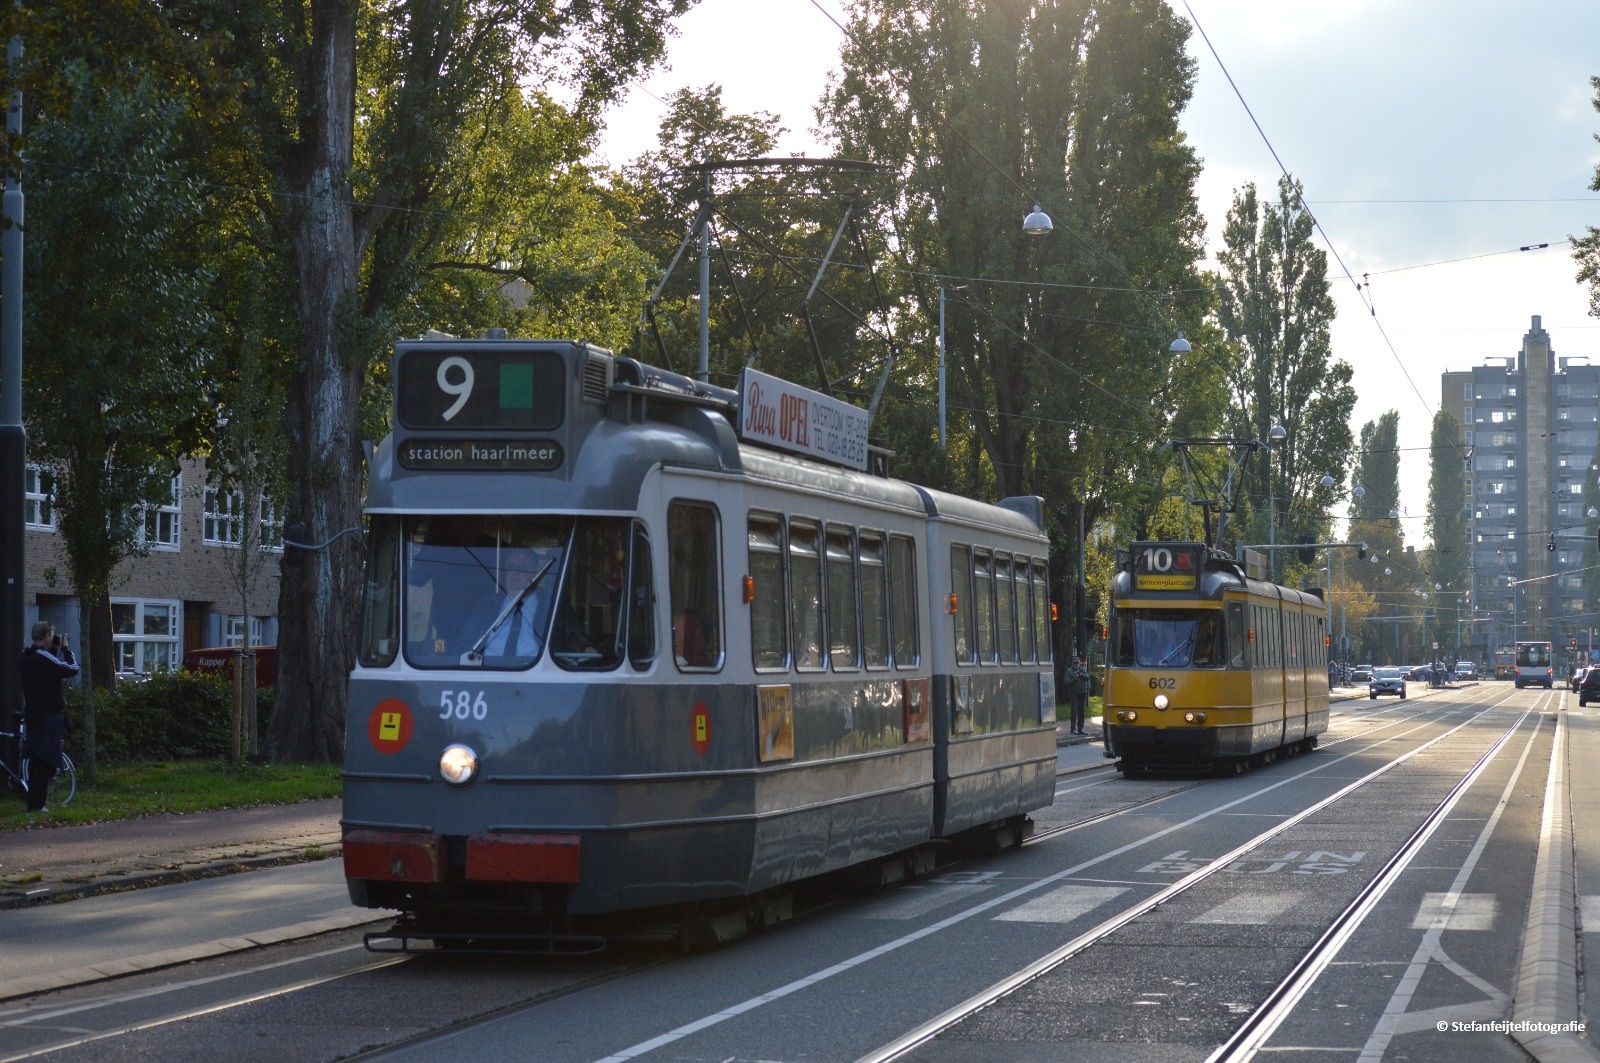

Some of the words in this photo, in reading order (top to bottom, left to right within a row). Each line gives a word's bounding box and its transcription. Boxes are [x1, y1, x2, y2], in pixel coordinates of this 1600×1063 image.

[436, 356, 475, 422] 9
[745, 381, 776, 438] Riva
[779, 392, 810, 448] OPEL
[812, 402, 843, 431] OVERTOOM
[409, 446, 462, 460] station
[1143, 548, 1172, 572] 10
[1139, 577, 1194, 588] weteringplantsoen
[198, 656, 226, 668] Kapper
[1149, 677, 1176, 690] 602
[439, 690, 488, 721] 586
[1134, 861, 1356, 875] BUS
